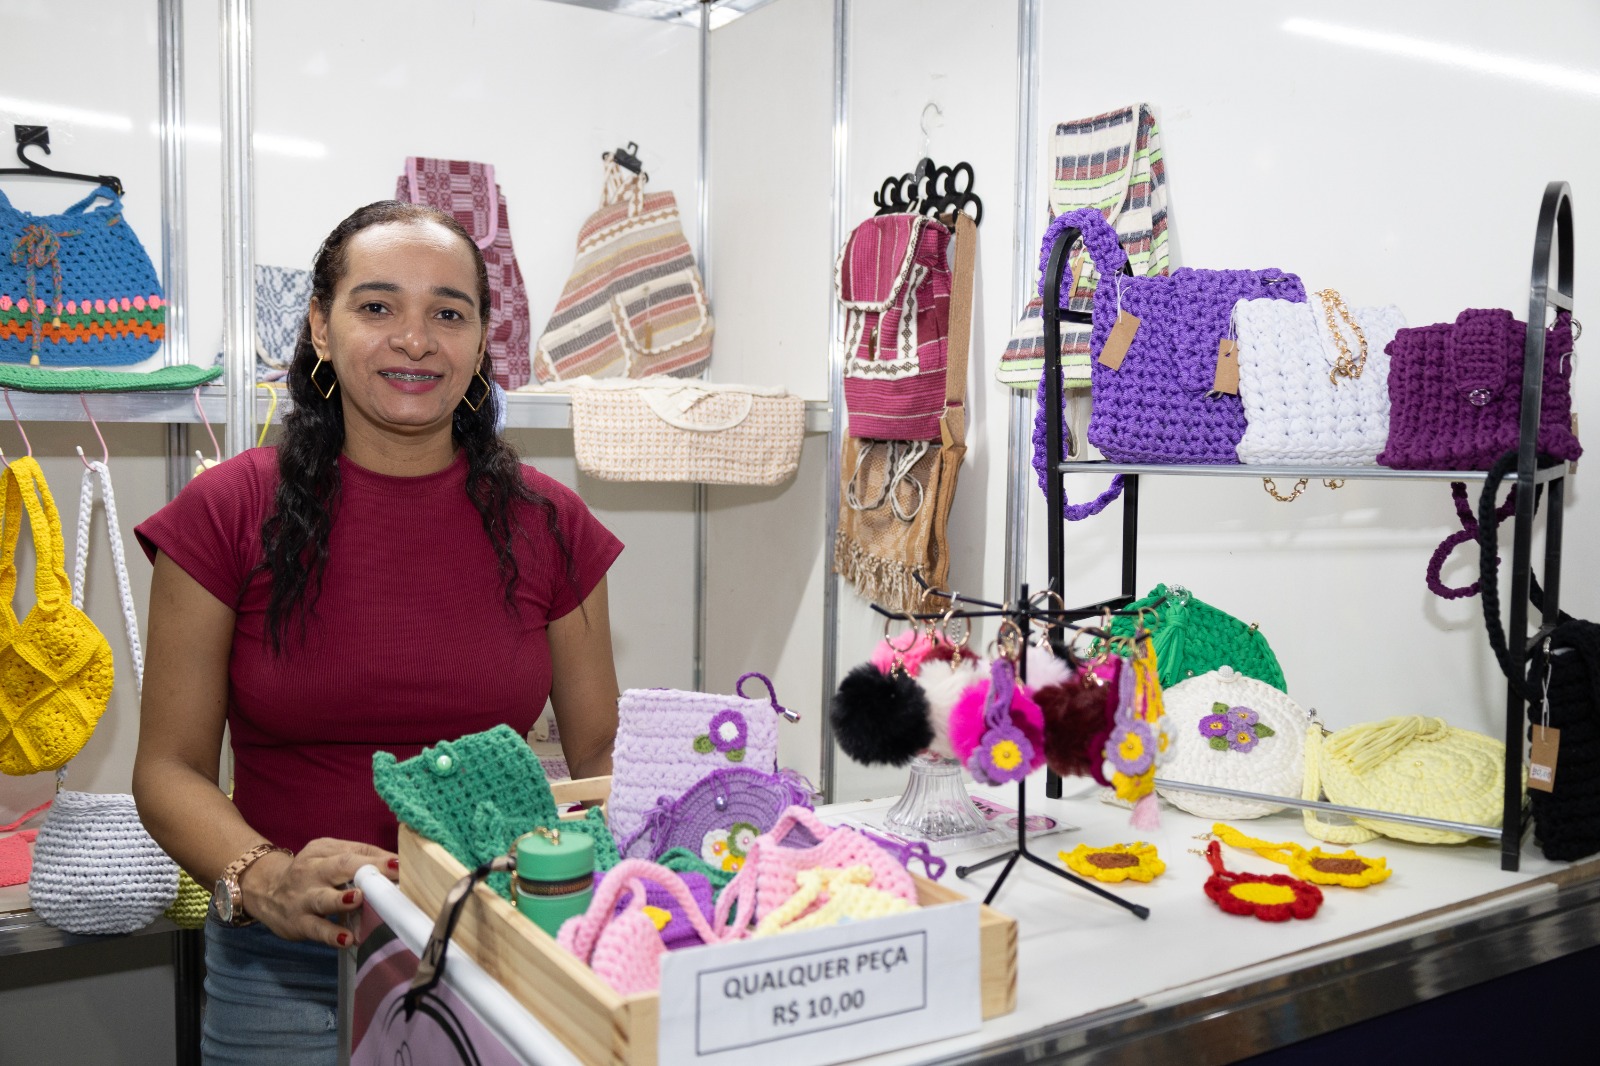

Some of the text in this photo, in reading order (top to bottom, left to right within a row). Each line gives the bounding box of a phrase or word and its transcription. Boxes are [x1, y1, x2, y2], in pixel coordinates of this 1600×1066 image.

[723, 946, 908, 999] QUALQUER PEÇA
[772, 990, 865, 1026] R$ 10,00
